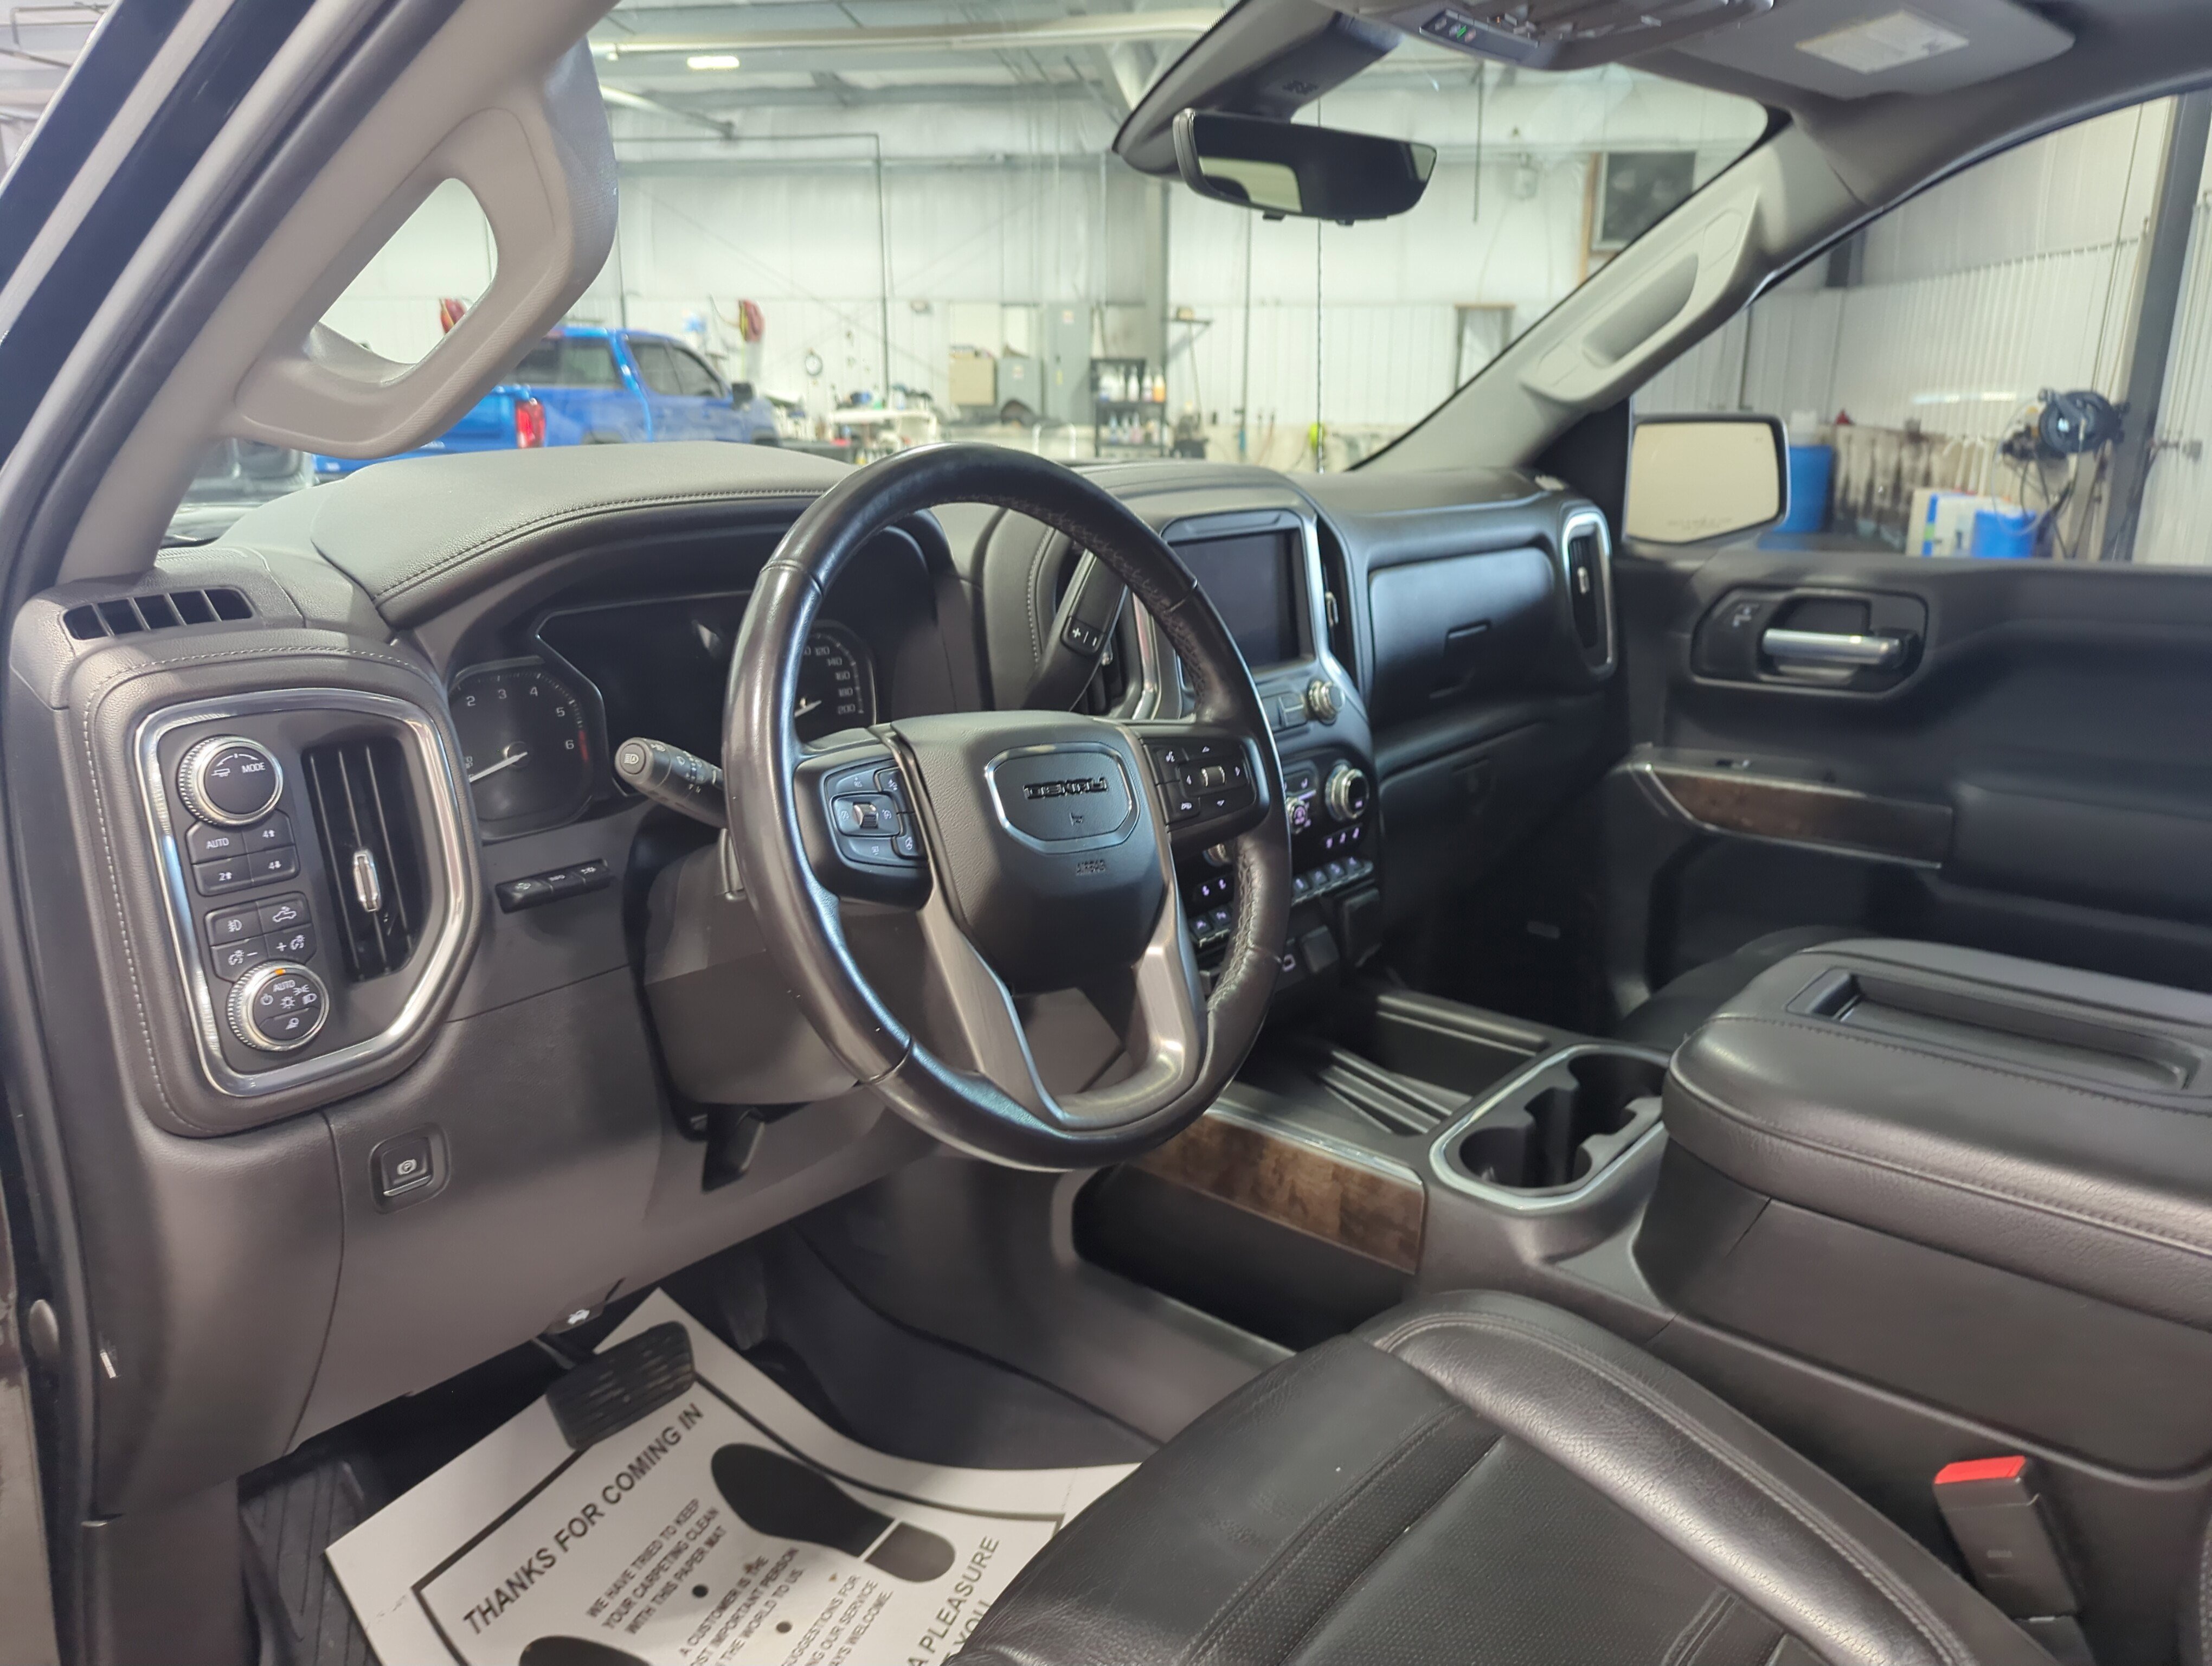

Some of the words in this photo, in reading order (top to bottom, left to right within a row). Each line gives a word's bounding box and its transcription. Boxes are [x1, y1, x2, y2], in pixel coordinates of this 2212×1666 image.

[466, 696, 475, 706] 2
[498, 689, 507, 699] 3
[530, 687, 538, 696] 4
[556, 707, 565, 717] 5
[241, 762, 266, 773] MODE
[565, 740, 575, 749] 6
[206, 837, 229, 849] AUTO
[273, 979, 295, 992] AUTO
[463, 1547, 556, 1635] THANKS
[554, 1503, 605, 1552] FOR
[602, 1426, 681, 1504] COMING
[678, 1402, 704, 1430] IN
[586, 1597, 609, 1618] WE
[605, 1568, 636, 1599] HAVE
[631, 1539, 663, 1571] TRIED
[659, 1524, 677, 1540] TO
[674, 1498, 699, 1526] KEEP
[601, 1597, 636, 1629] YOUR
[632, 1540, 689, 1598] CARPETING
[685, 1507, 719, 1541] CLEAN
[625, 1605, 657, 1635] WITH
[651, 1580, 678, 1605] THIS
[673, 1546, 710, 1581] PAPER
[704, 1525, 727, 1549] MAT
[709, 1587, 764, 1648] IMPORTANT
[760, 1547, 800, 1588] PERSON
[838, 1574, 861, 1596] FOR
[918, 1535, 1000, 1654] PLEASURE
[679, 1647, 692, 1657] A
[687, 1588, 743, 1646] CUSTOMER
[736, 1577, 752, 1589] IS
[719, 1638, 746, 1661] THE
[739, 1599, 777, 1638] WORLD
[771, 1583, 790, 1598] TO
[820, 1625, 844, 1649] OUR
[839, 1579, 878, 1625] SERVICE
